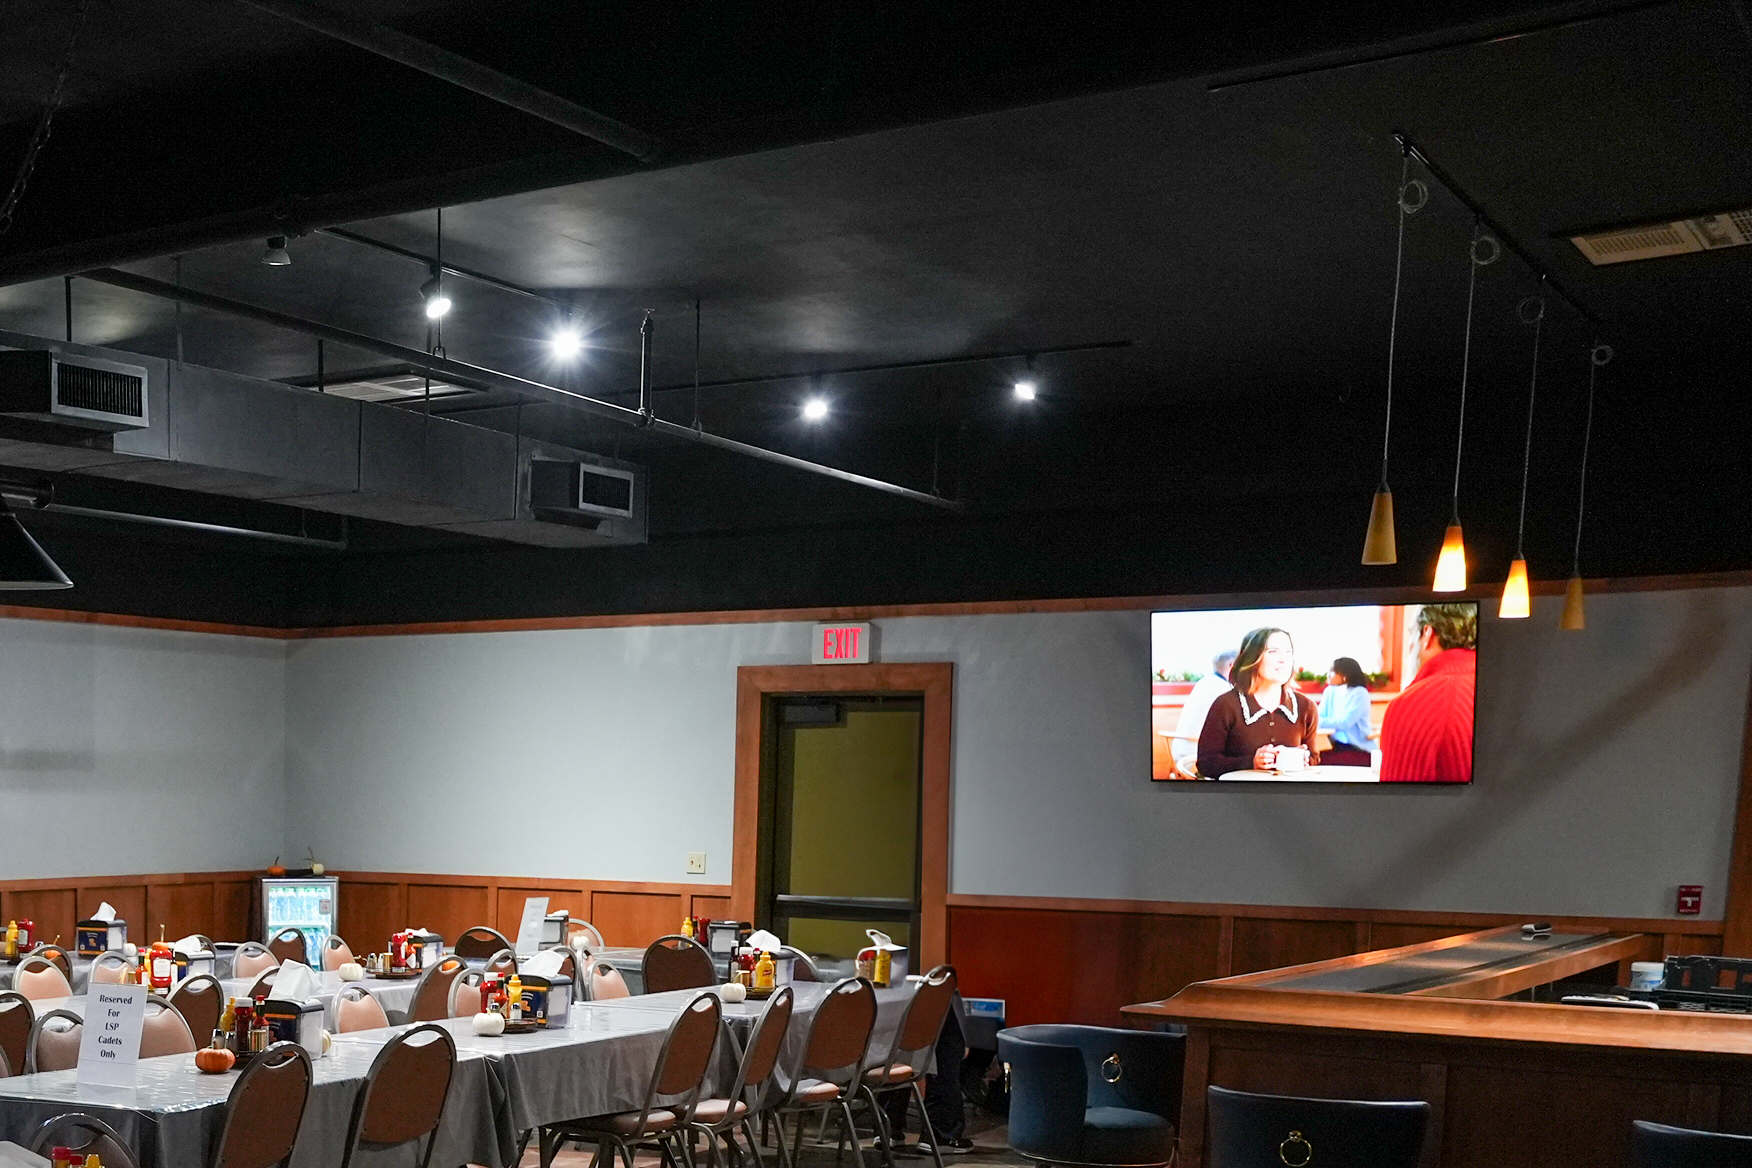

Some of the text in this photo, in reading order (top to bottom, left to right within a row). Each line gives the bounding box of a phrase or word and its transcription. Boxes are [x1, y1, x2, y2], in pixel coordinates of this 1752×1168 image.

[823, 627, 862, 659] EXIT
[99, 994, 133, 1005] Reserved
[107, 1008, 120, 1017] For
[105, 1022, 120, 1031] LSP
[98, 1035, 123, 1045] Cadets
[100, 1049, 116, 1060] Only
